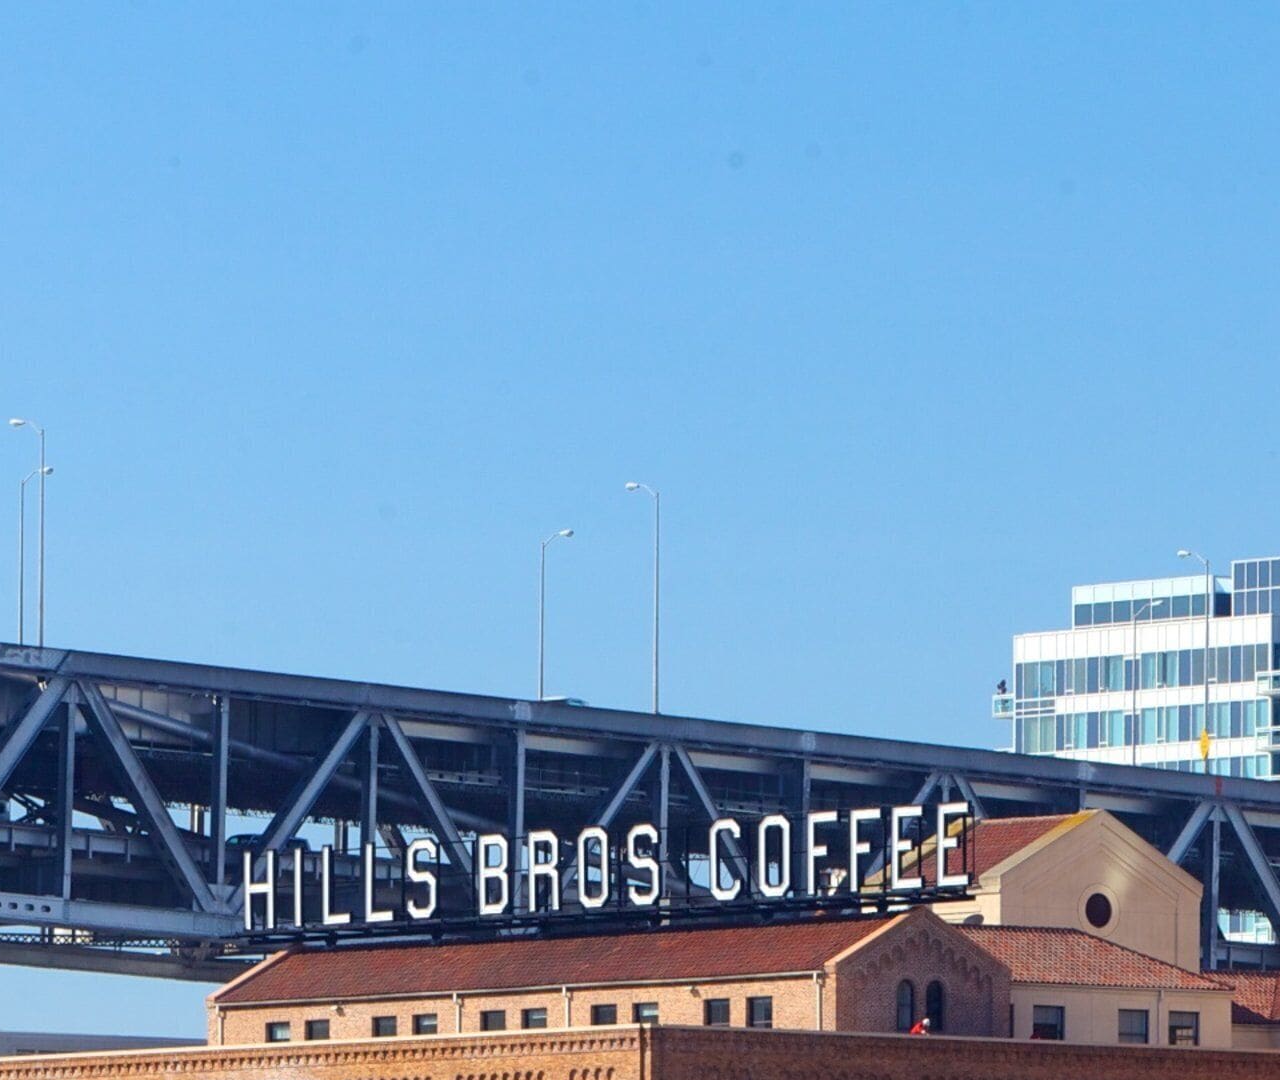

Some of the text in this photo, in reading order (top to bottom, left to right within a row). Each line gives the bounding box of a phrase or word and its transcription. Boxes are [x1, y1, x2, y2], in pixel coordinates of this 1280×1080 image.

[243, 802, 969, 931] HILLS BROS COFFEE
